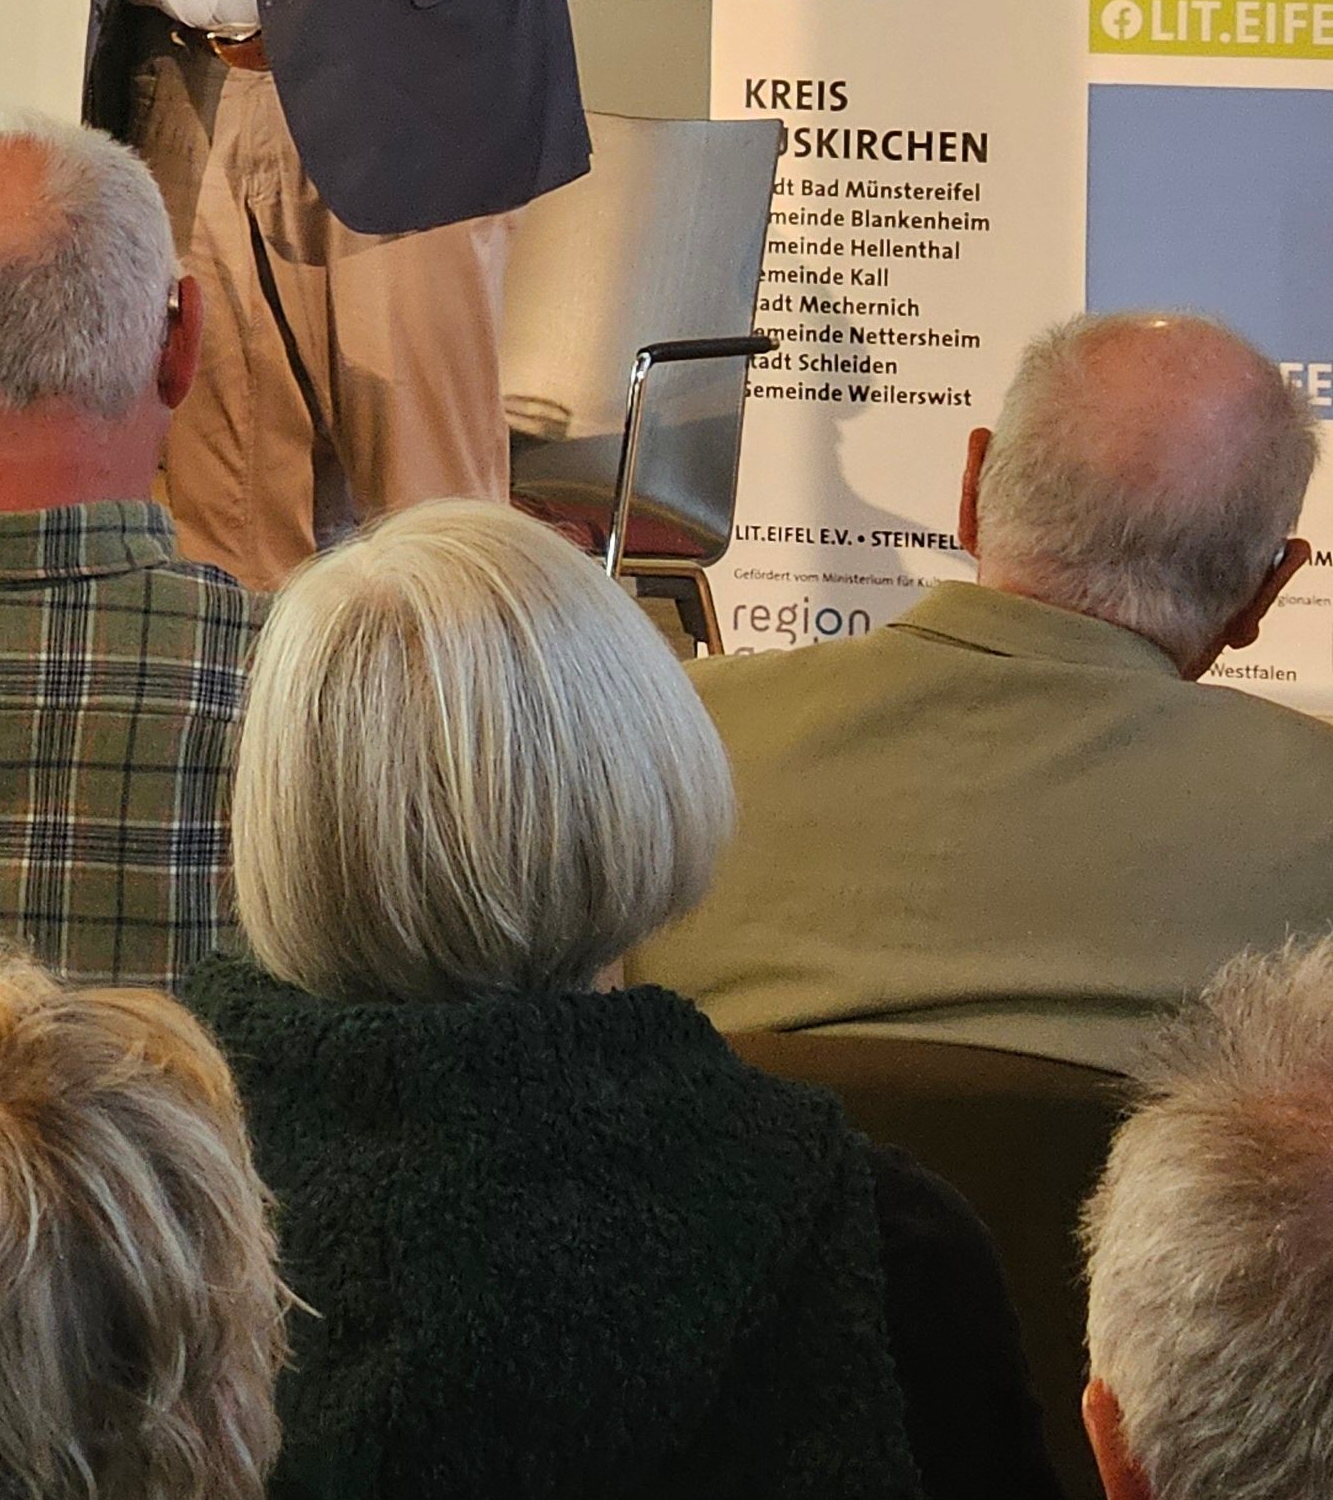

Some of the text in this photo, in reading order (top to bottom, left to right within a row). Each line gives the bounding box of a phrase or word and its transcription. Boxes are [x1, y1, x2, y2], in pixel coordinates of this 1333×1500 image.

[745, 79, 848, 112] KREIS
[802, 180, 839, 196] Bad
[846, 181, 980, 202] Münstereifel
[769, 208, 990, 231] meinde Blankenheim
[768, 238, 960, 259] meinde Hellenthal
[851, 269, 889, 286] Kall
[799, 297, 919, 316] Mechernich
[850, 327, 980, 348] Nettersheim
[750, 352, 897, 374] tadt Schleiden
[849, 384, 971, 406] Weilerswist
[735, 525, 814, 544] LIT.EIFEL
[734, 568, 789, 581] Gefördert
[792, 572, 819, 582] vom
[822, 572, 893, 586] Ministerium
[896, 575, 915, 586] für
[733, 596, 870, 644] region
